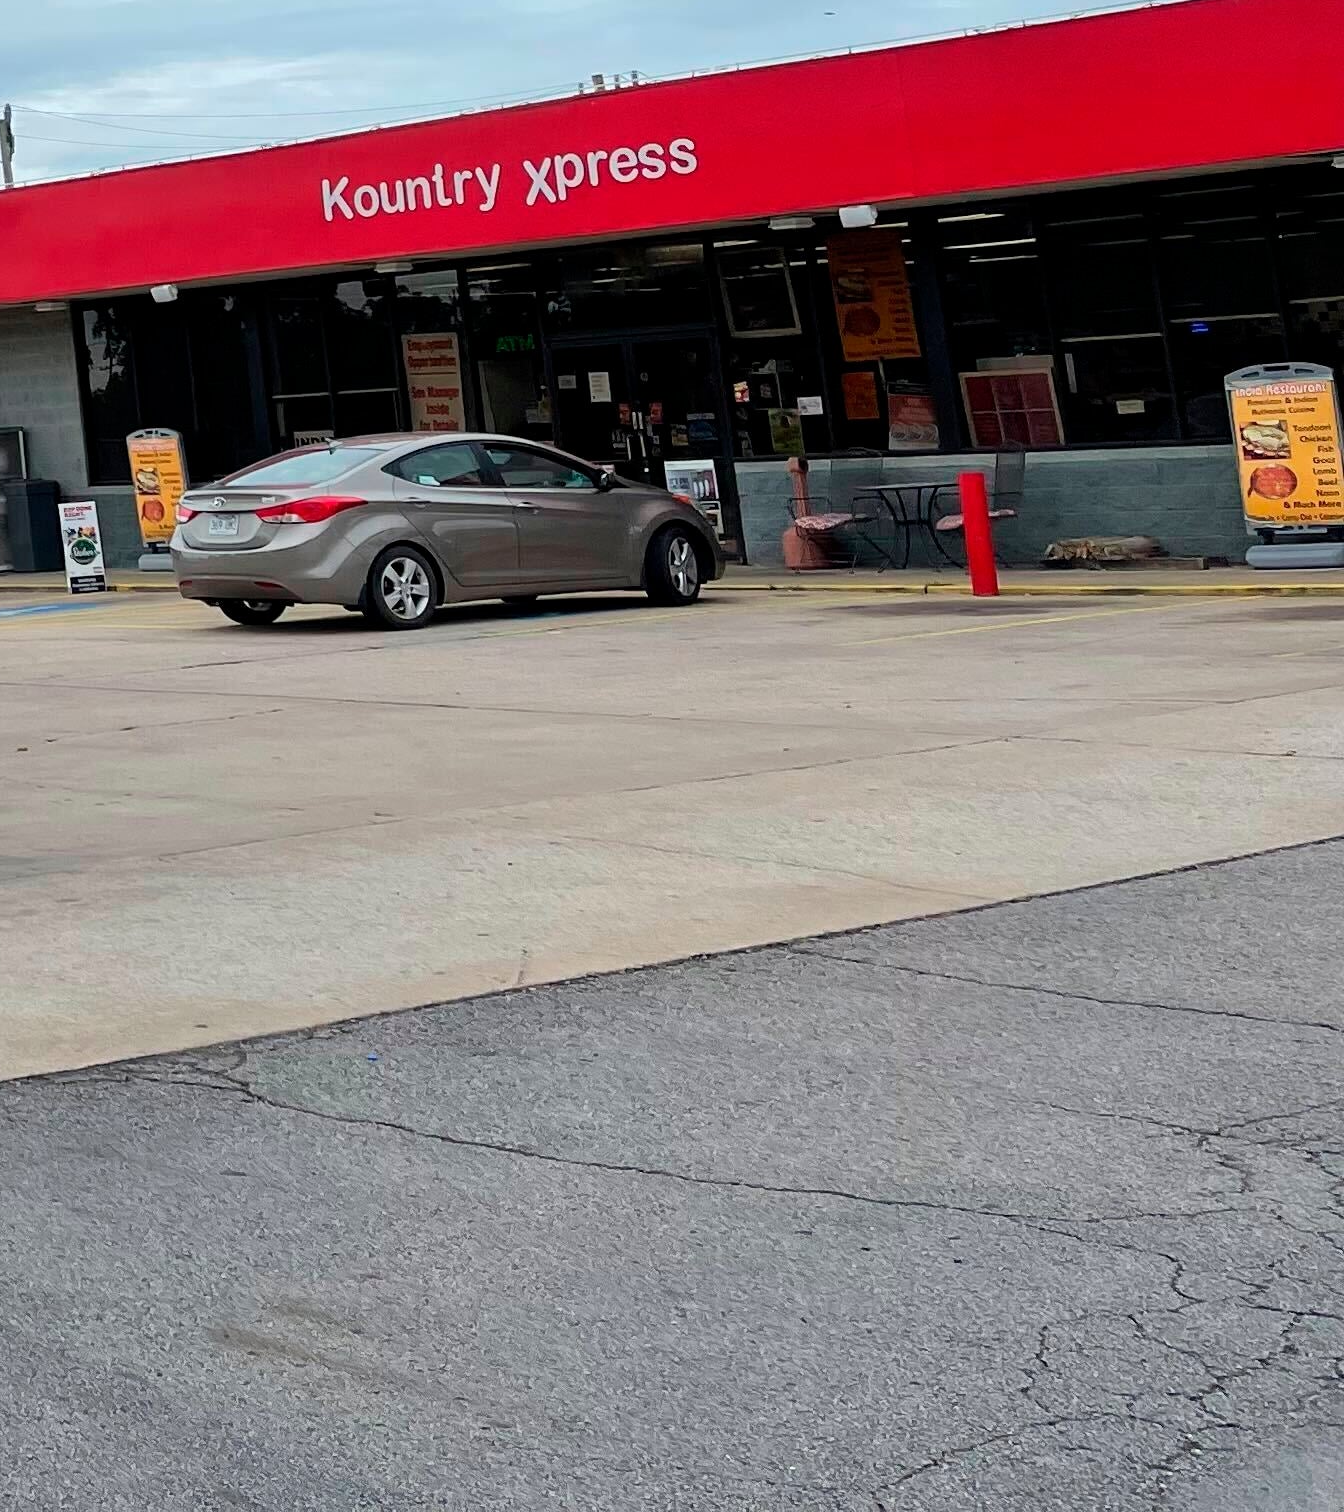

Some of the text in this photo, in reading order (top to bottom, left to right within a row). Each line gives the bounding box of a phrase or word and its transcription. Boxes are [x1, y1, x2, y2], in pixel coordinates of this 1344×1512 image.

[321, 163, 502, 222] Kountry
[1300, 435, 1333, 443] Chicken
[1318, 500, 1342, 508] More
